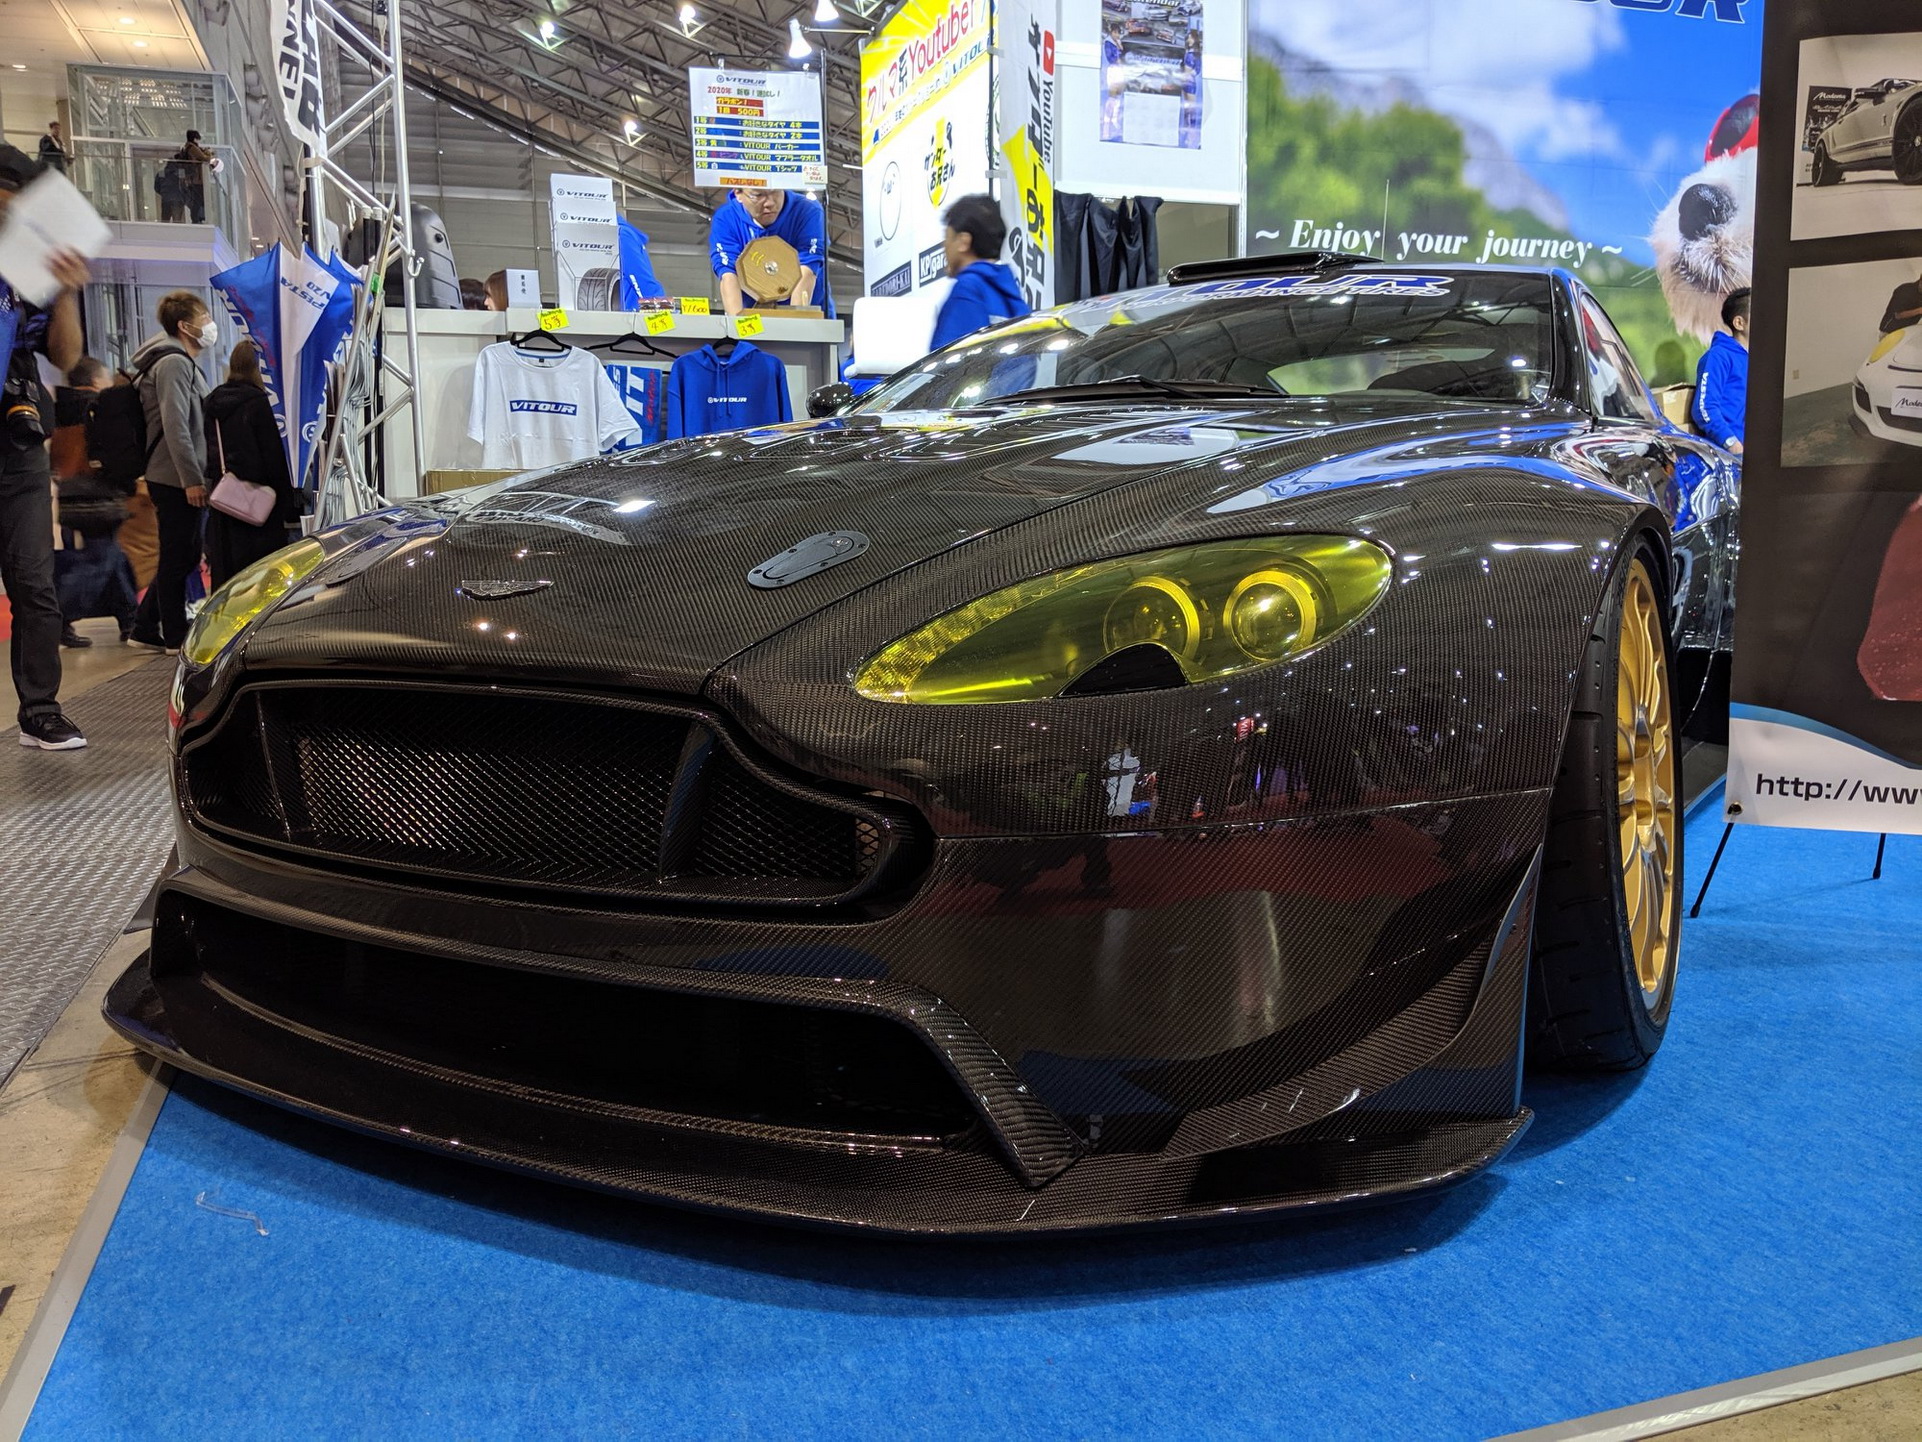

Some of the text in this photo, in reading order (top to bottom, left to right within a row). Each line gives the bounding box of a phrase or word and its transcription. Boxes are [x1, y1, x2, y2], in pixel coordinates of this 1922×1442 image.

[725, 77, 766, 85] VITOUR
[707, 86, 732, 95] 2020年
[737, 107, 761, 117] 500円
[744, 142, 771, 150] VITOUR
[744, 153, 771, 161] VITOUR
[744, 164, 772, 172] VITOUR
[566, 191, 609, 199] VITOUR
[570, 215, 612, 223] VITOUR
[572, 242, 615, 250] VITOUR
[1289, 219, 1381, 257] Enjoy
[1397, 230, 1469, 260] your
[1476, 229, 1593, 268] journey
[511, 401, 576, 414] VITOUR
